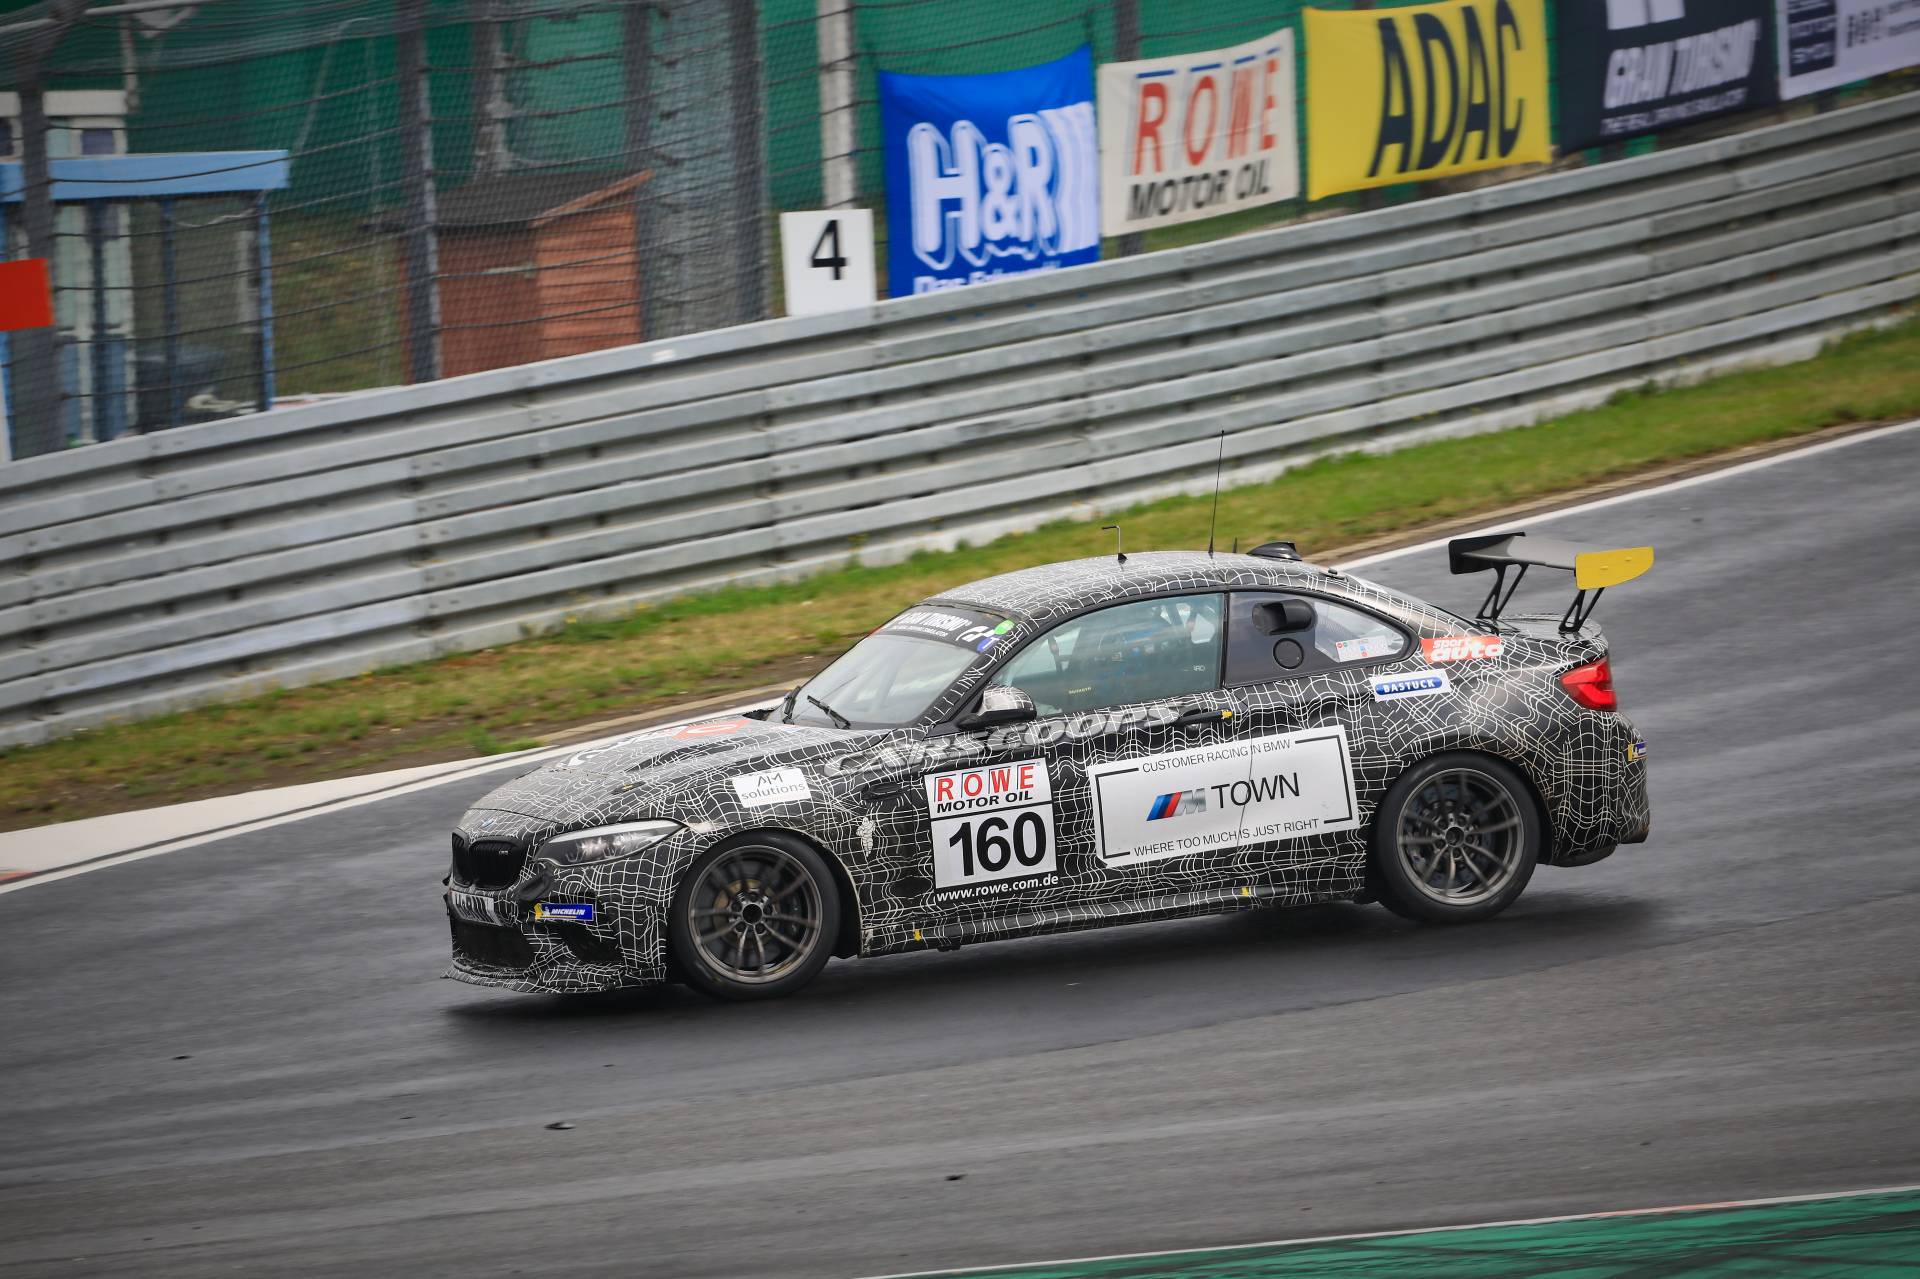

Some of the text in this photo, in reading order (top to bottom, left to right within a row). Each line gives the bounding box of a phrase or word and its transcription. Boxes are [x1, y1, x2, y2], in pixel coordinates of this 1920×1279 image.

[1366, 0, 1526, 177] ADAC
[1133, 58, 1280, 176] ROWE
[907, 113, 1060, 270] H&R
[1126, 158, 1272, 220] MOTOR OIL
[810, 219, 847, 281] 4
[1430, 641, 1505, 662] auto
[1383, 679, 1436, 694] BASTUCK
[1142, 738, 1292, 773] CUSTOMER RACING IN BMW
[741, 783, 806, 800] solutions
[935, 765, 1034, 802] ROWE
[936, 790, 1034, 813] MOTOR OIL
[1211, 771, 1301, 809] TOWN
[948, 811, 1047, 877] 160
[1134, 818, 1320, 858] WHERE TOO MUCH IS JUST RIGHT
[936, 873, 1060, 902] www.rowe.com.de
[551, 908, 586, 916] MICHELIN
